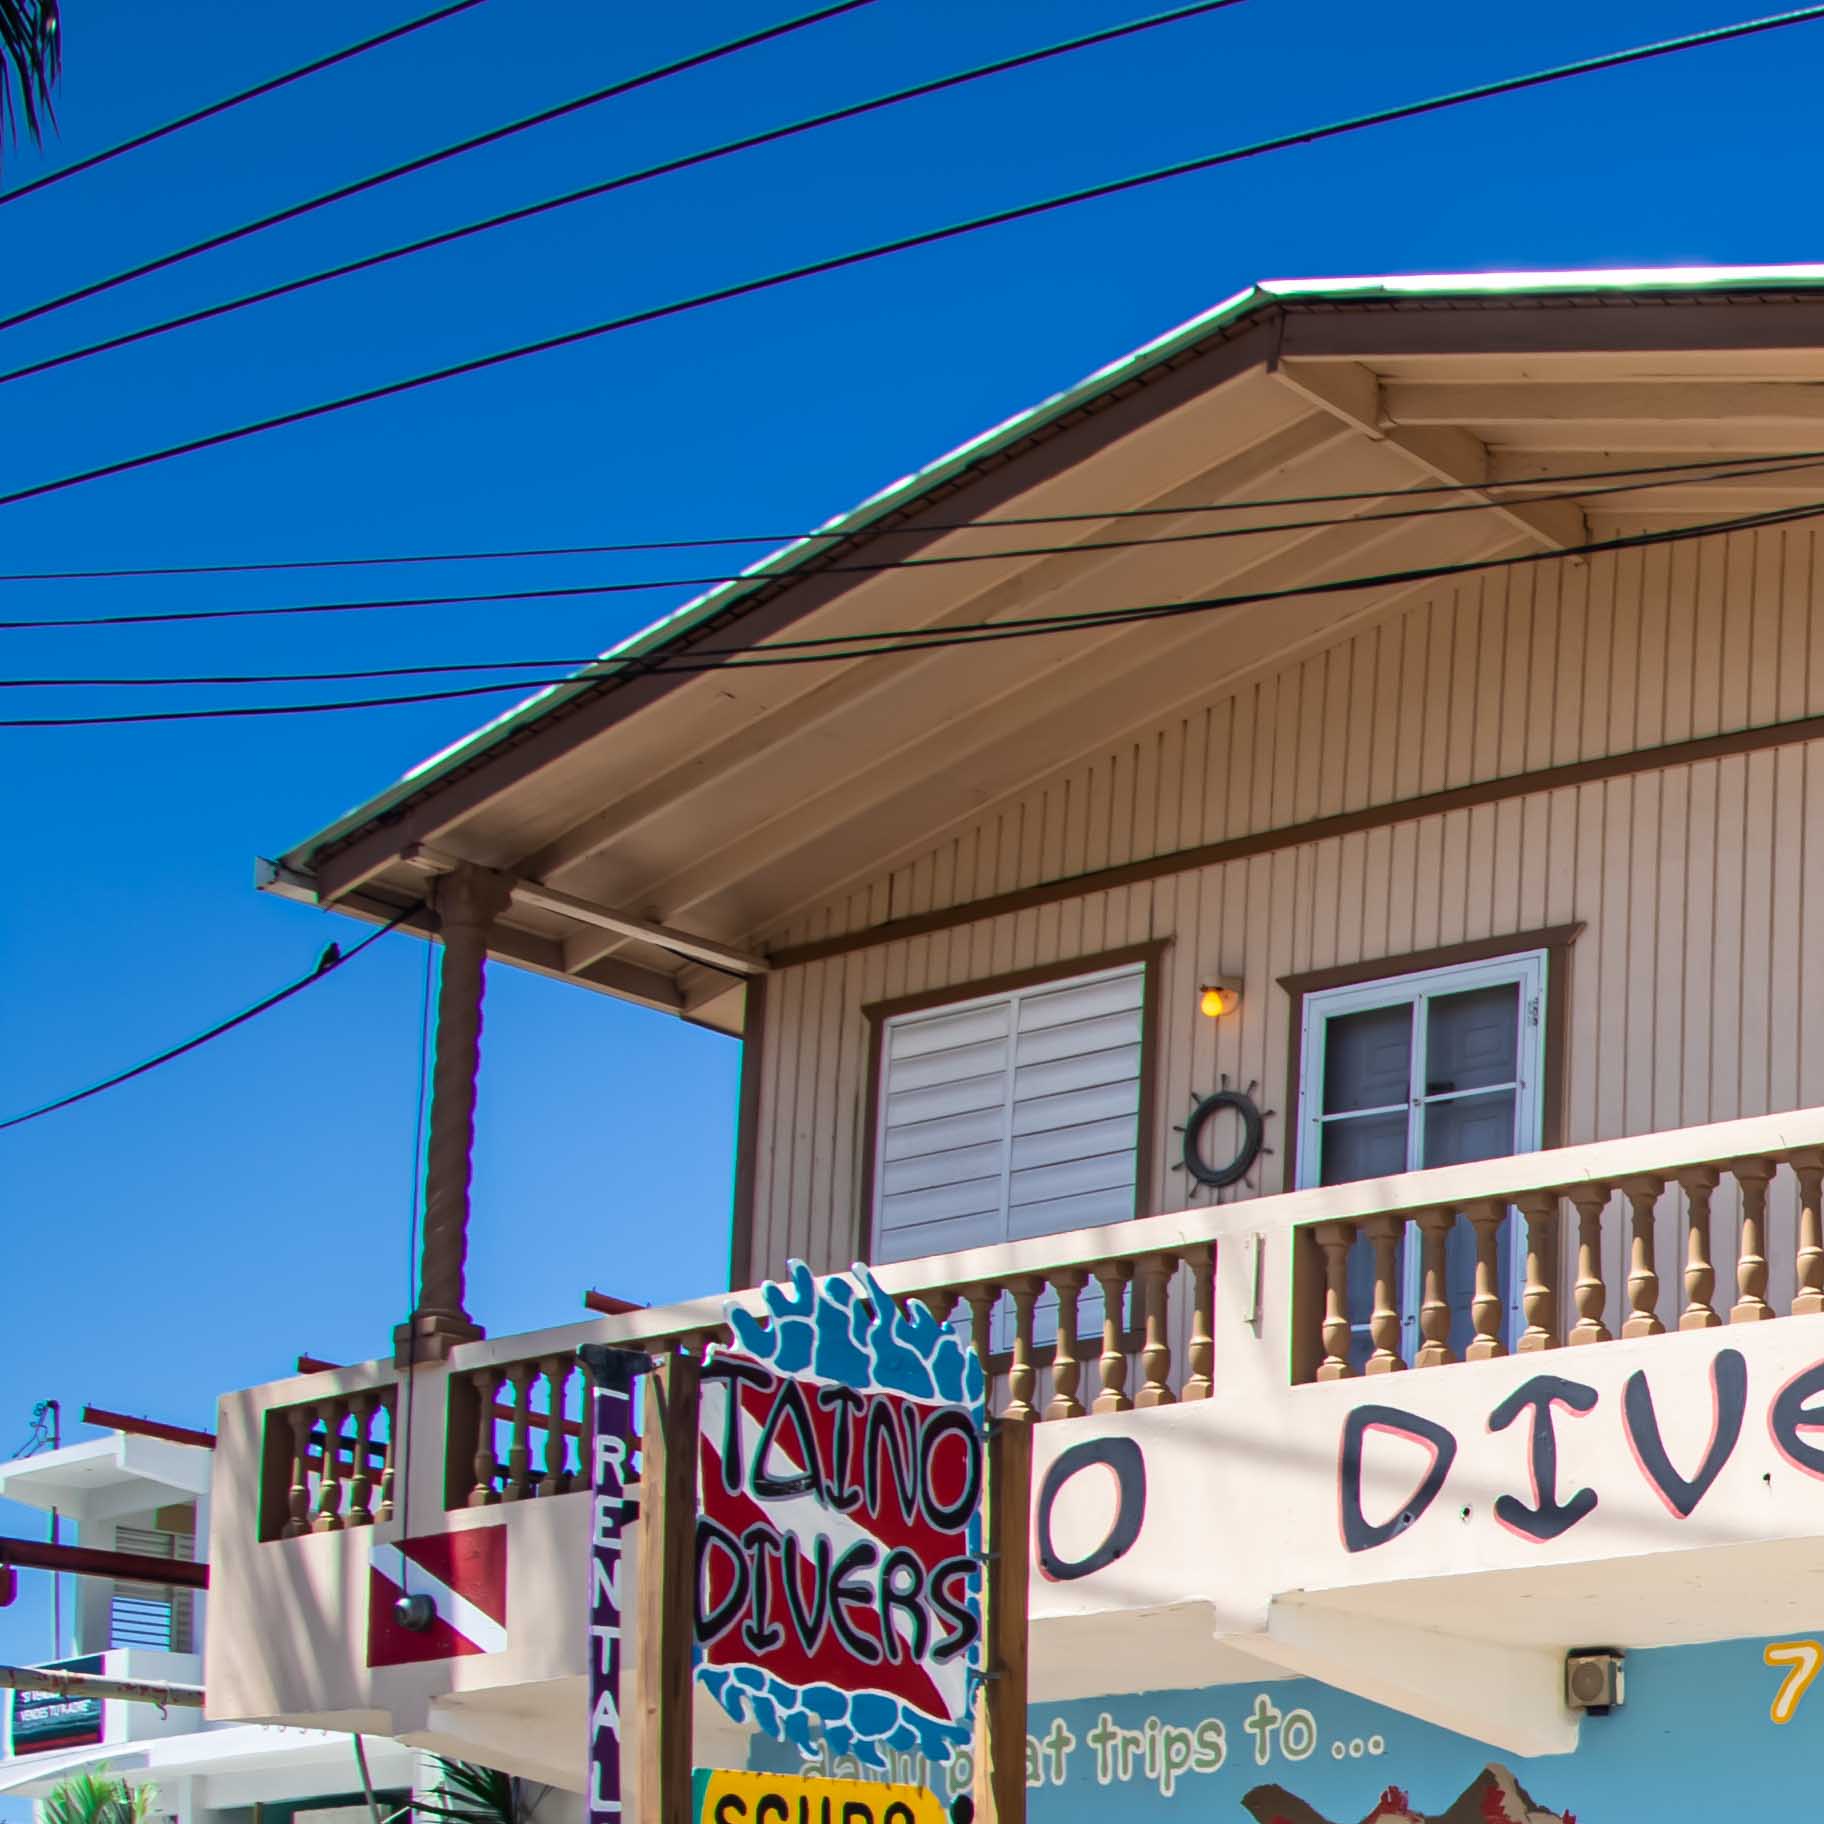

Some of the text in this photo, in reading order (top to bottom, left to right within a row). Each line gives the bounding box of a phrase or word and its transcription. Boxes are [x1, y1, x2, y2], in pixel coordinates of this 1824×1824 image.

[700, 1358, 982, 1534] TAINO
[694, 1516, 979, 1665] DIVERS
[1086, 1713, 1227, 1797] trips
